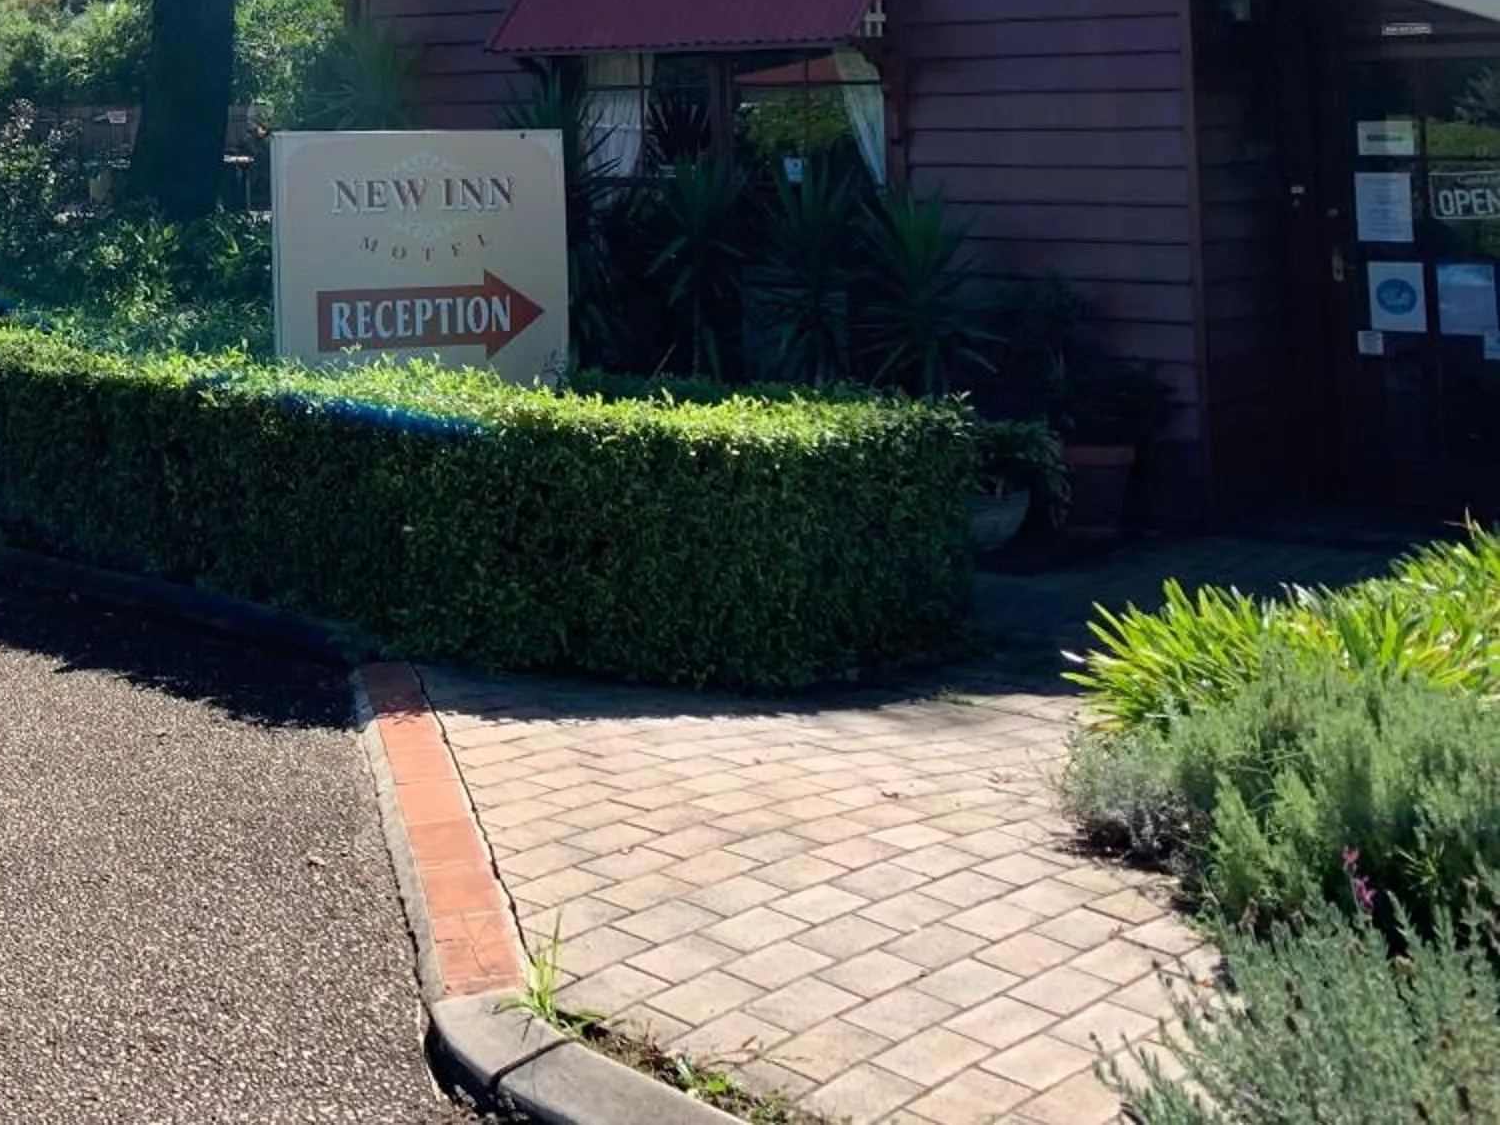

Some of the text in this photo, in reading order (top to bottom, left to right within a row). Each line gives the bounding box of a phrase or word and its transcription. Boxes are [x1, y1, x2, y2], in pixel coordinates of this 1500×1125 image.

[330, 175, 516, 214] NEW INN
[1438, 187, 1500, 216] OPEN
[358, 233, 494, 263] MOTEL
[330, 294, 512, 341] RECEPTION
